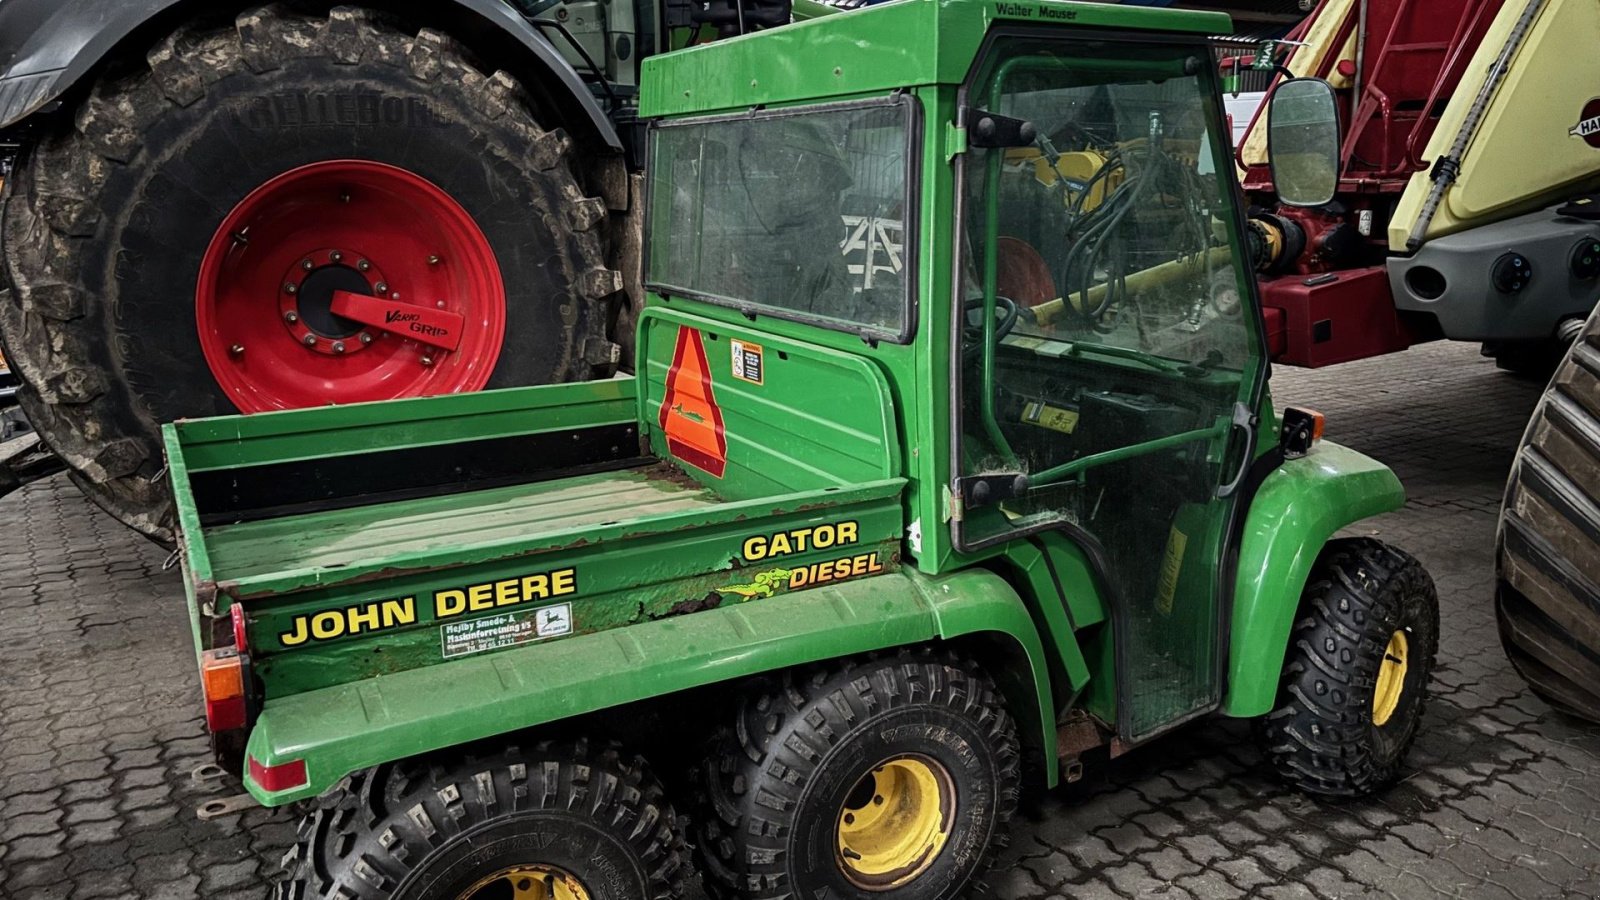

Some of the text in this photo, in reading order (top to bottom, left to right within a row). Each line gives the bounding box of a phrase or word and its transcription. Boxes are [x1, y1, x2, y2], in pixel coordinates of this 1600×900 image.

[995, 2, 1078, 20] Walter Mauser
[1581, 117, 1600, 134] HA
[409, 321, 449, 337] GRIP
[743, 521, 858, 561] GATOR
[788, 553, 882, 588] DIESEL
[280, 568, 576, 646] JOHN DEERE
